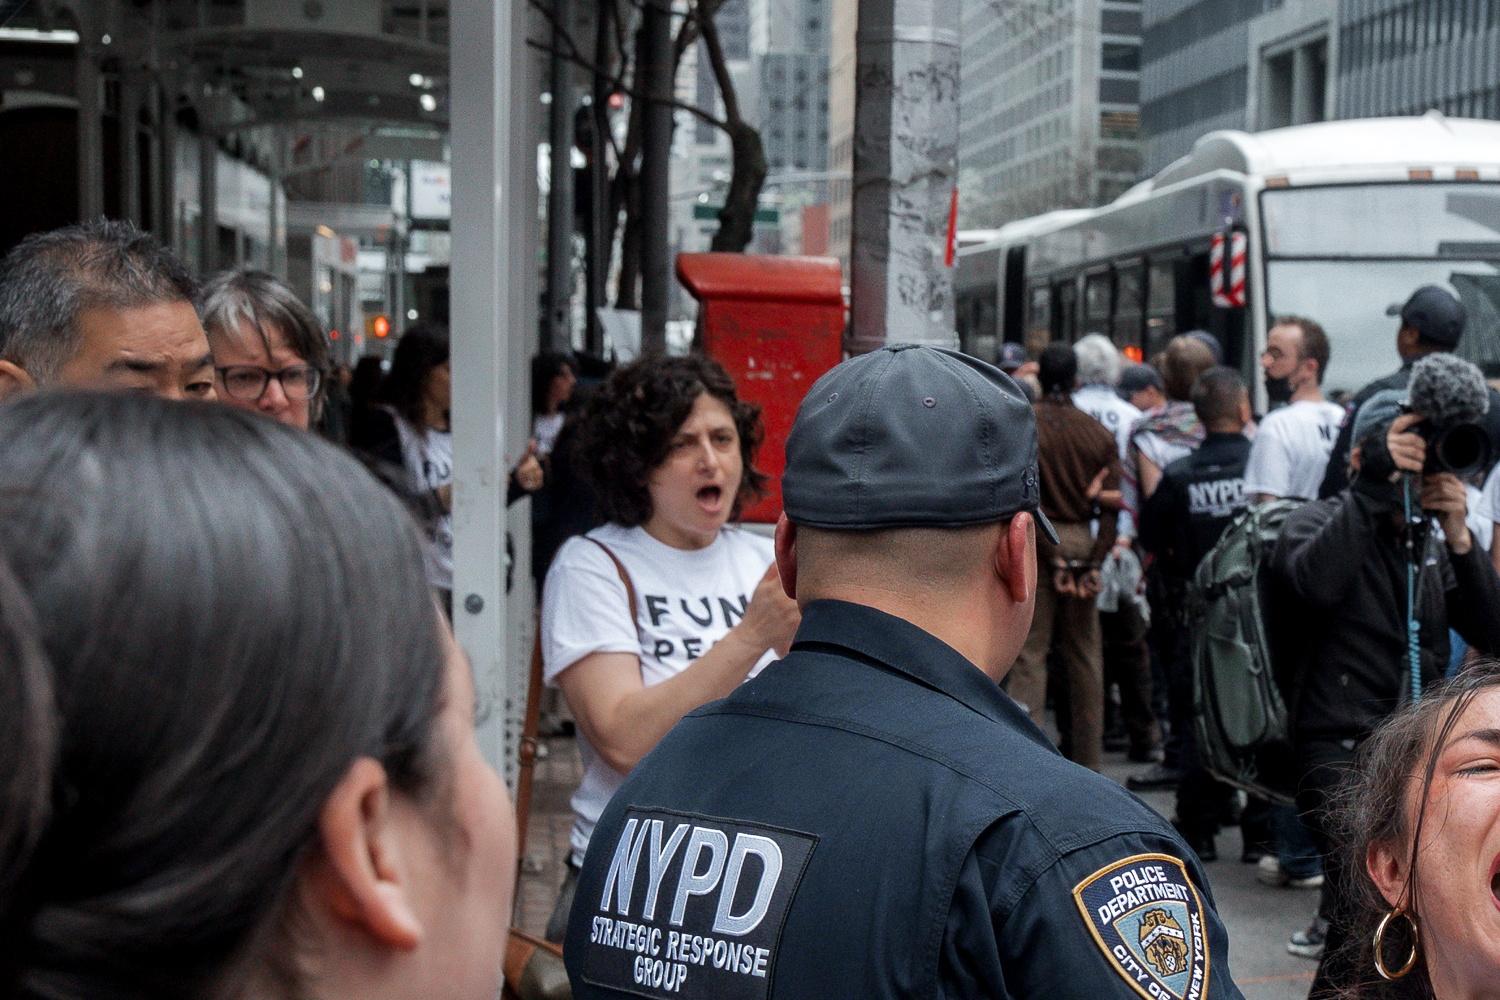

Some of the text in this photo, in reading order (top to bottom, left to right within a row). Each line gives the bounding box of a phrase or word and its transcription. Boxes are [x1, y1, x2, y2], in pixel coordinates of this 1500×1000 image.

[600, 818, 783, 937] NYPD
[1110, 866, 1167, 895] POLICE
[1097, 882, 1190, 926] DEPARTMENT
[590, 915, 770, 978] STRATEGIC RESPONSE
[1190, 911, 1203, 962] YORK
[633, 955, 688, 993] GROUP
[1113, 944, 1149, 982] CITY
